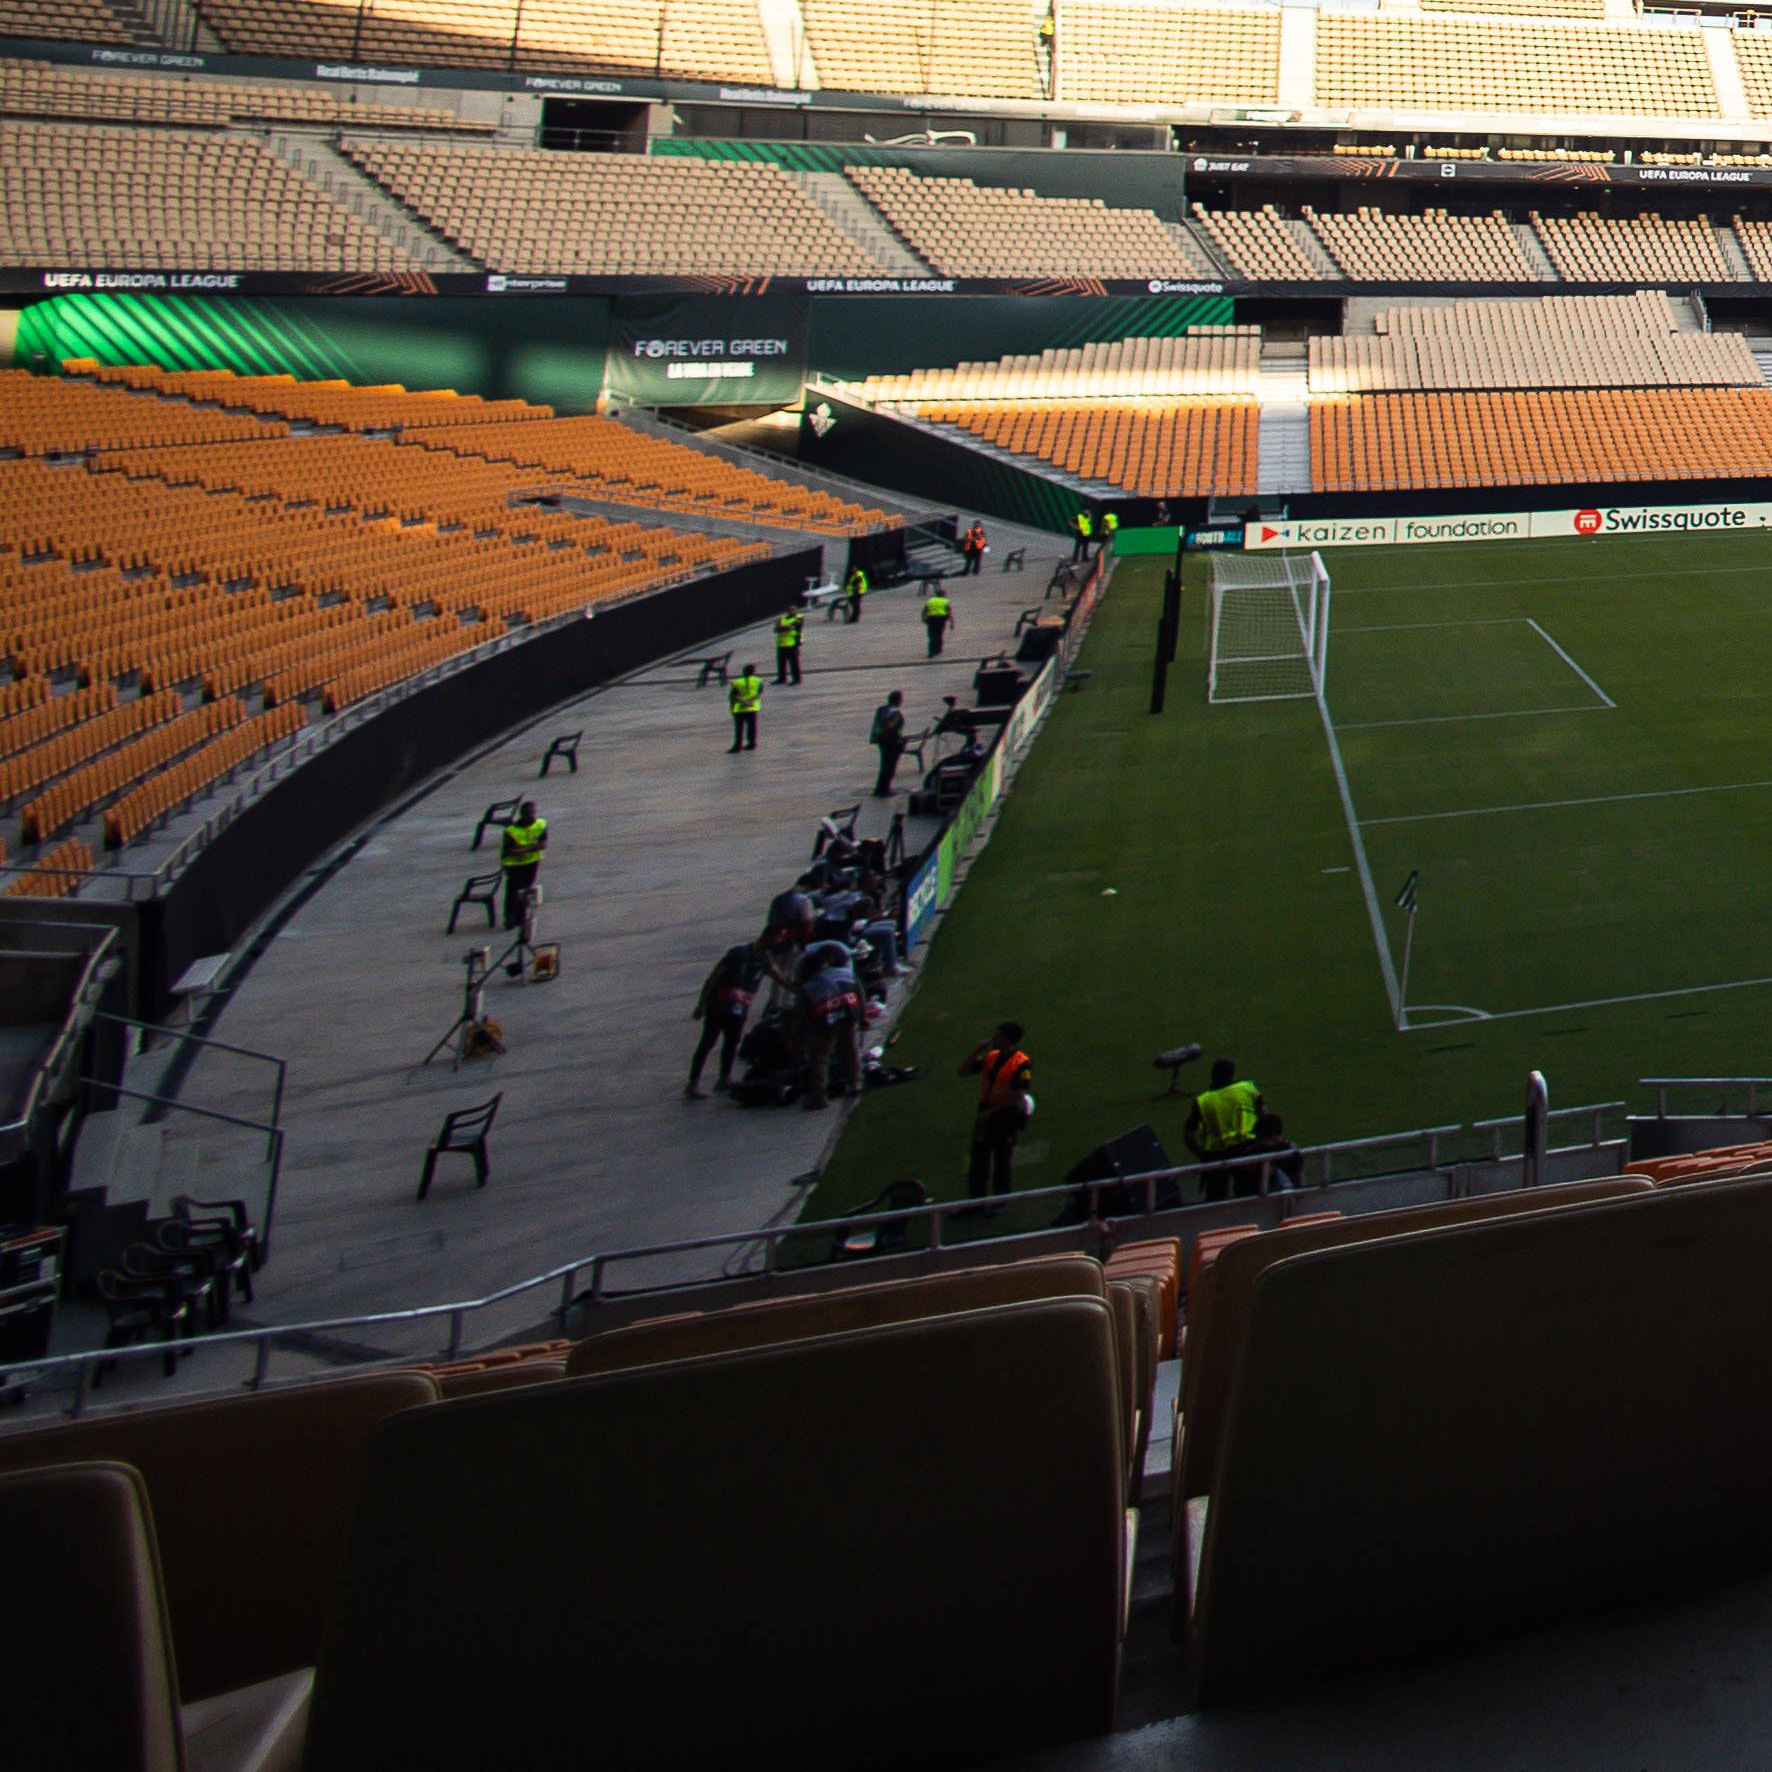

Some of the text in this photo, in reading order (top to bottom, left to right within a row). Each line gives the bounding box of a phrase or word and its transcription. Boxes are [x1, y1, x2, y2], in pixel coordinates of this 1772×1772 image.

[1639, 170, 1750, 181] UEFA EUROPA LEAGUE
[45, 273, 239, 288] UEFA EUROPA LEAGUE
[807, 280, 954, 292] UEFA EUROPA LEAGUE
[635, 339, 787, 357] FOREVER GREEN
[1605, 507, 1746, 530] Swissquote
[1297, 520, 1518, 542] kaizen foundation
